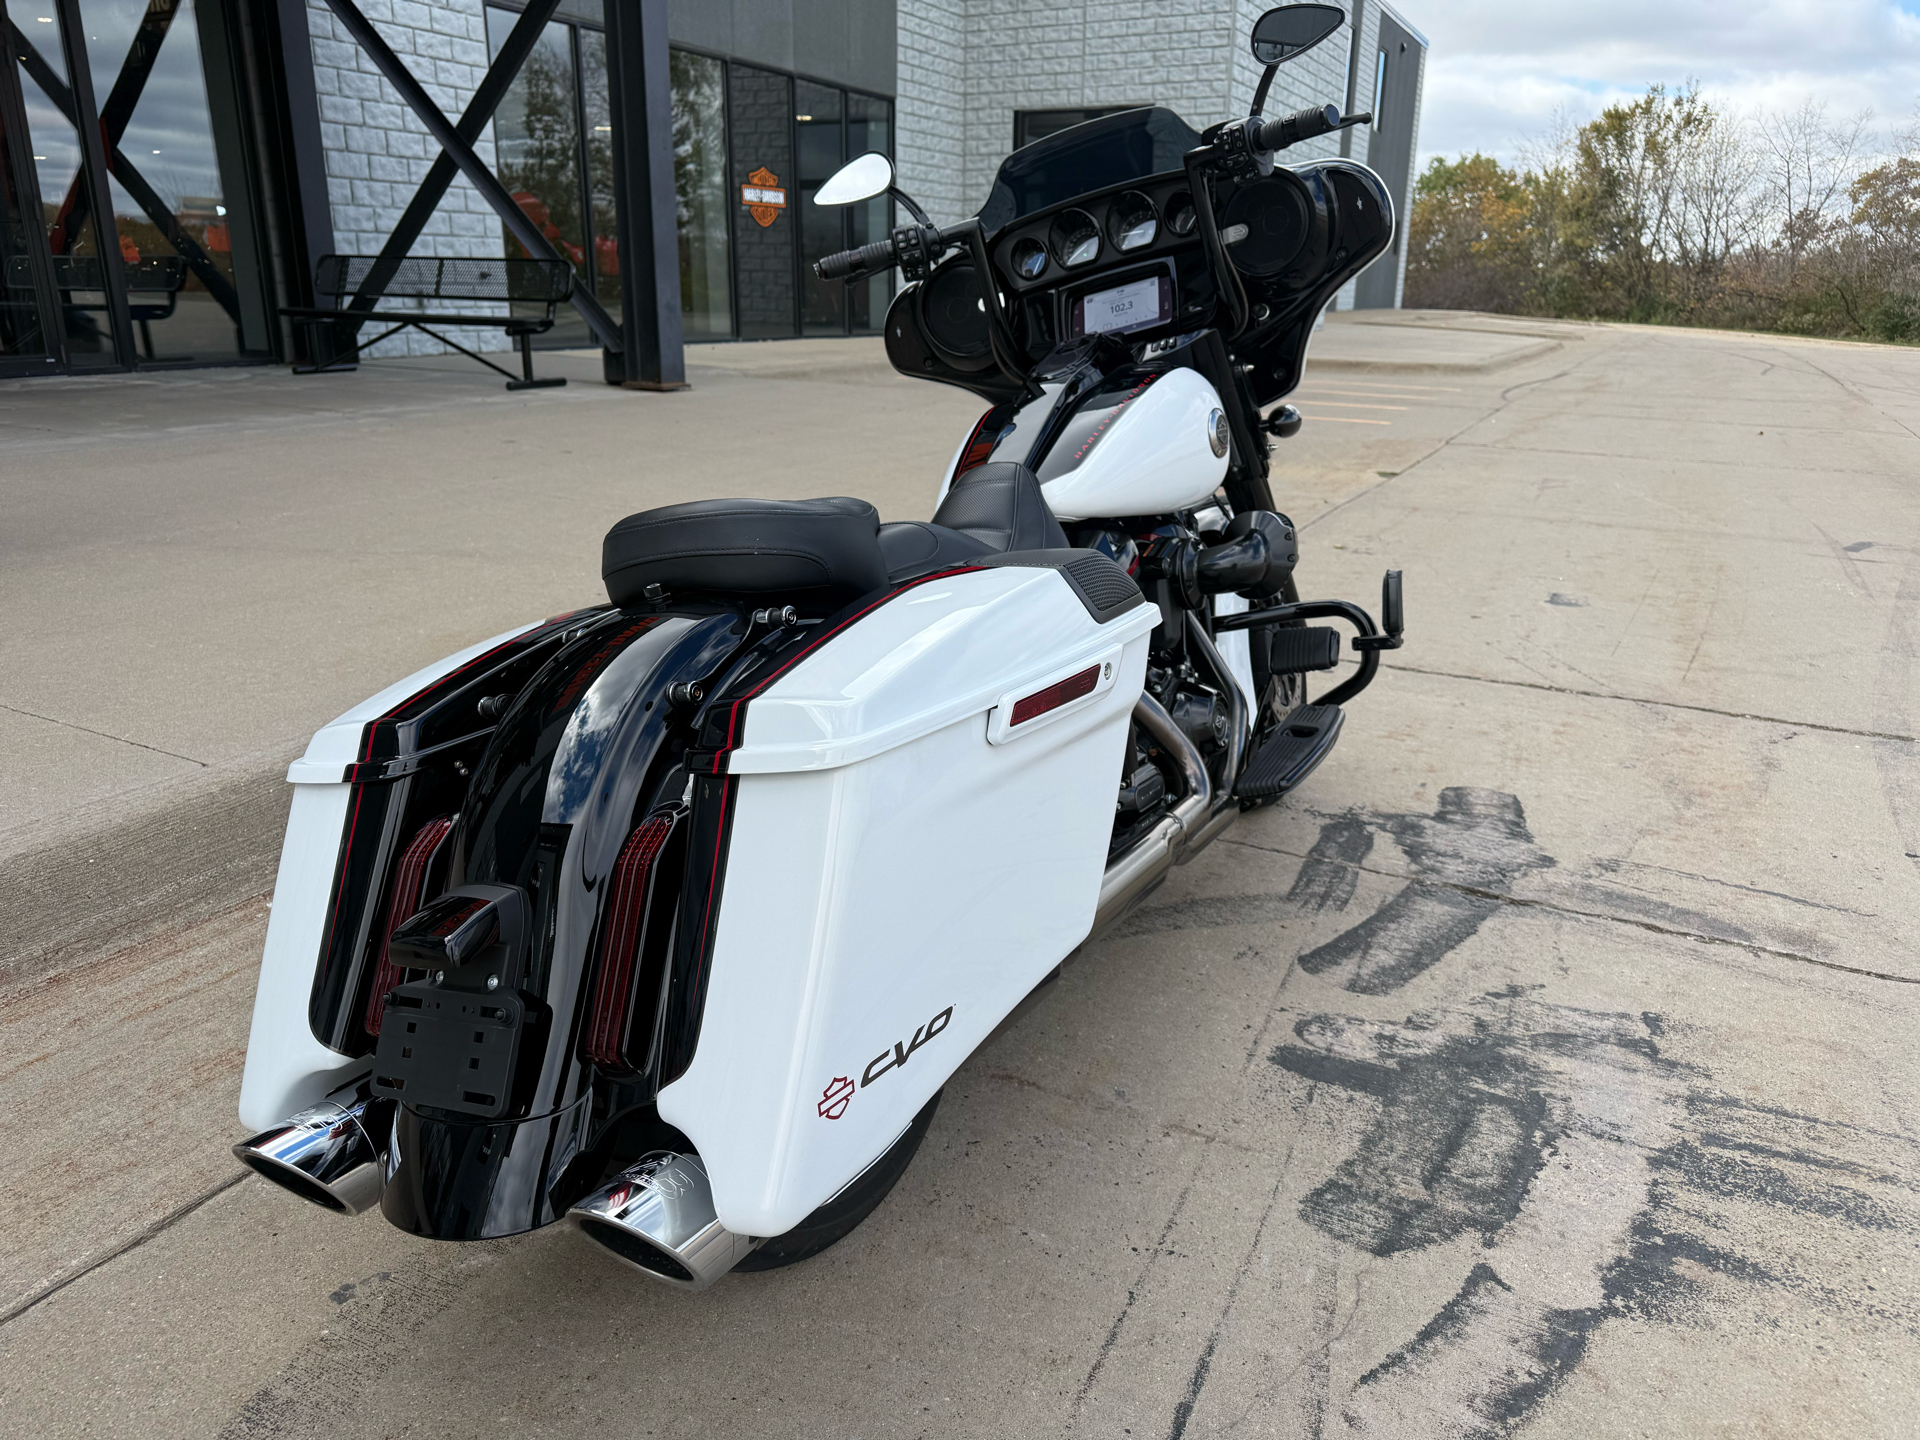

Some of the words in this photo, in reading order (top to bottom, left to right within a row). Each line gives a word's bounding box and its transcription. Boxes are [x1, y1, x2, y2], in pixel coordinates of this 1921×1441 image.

[1110, 300, 1134, 315] 102.3
[1074, 373, 1157, 459] HARLEY-DAVIDSON
[860, 1005, 954, 1089] CVO
